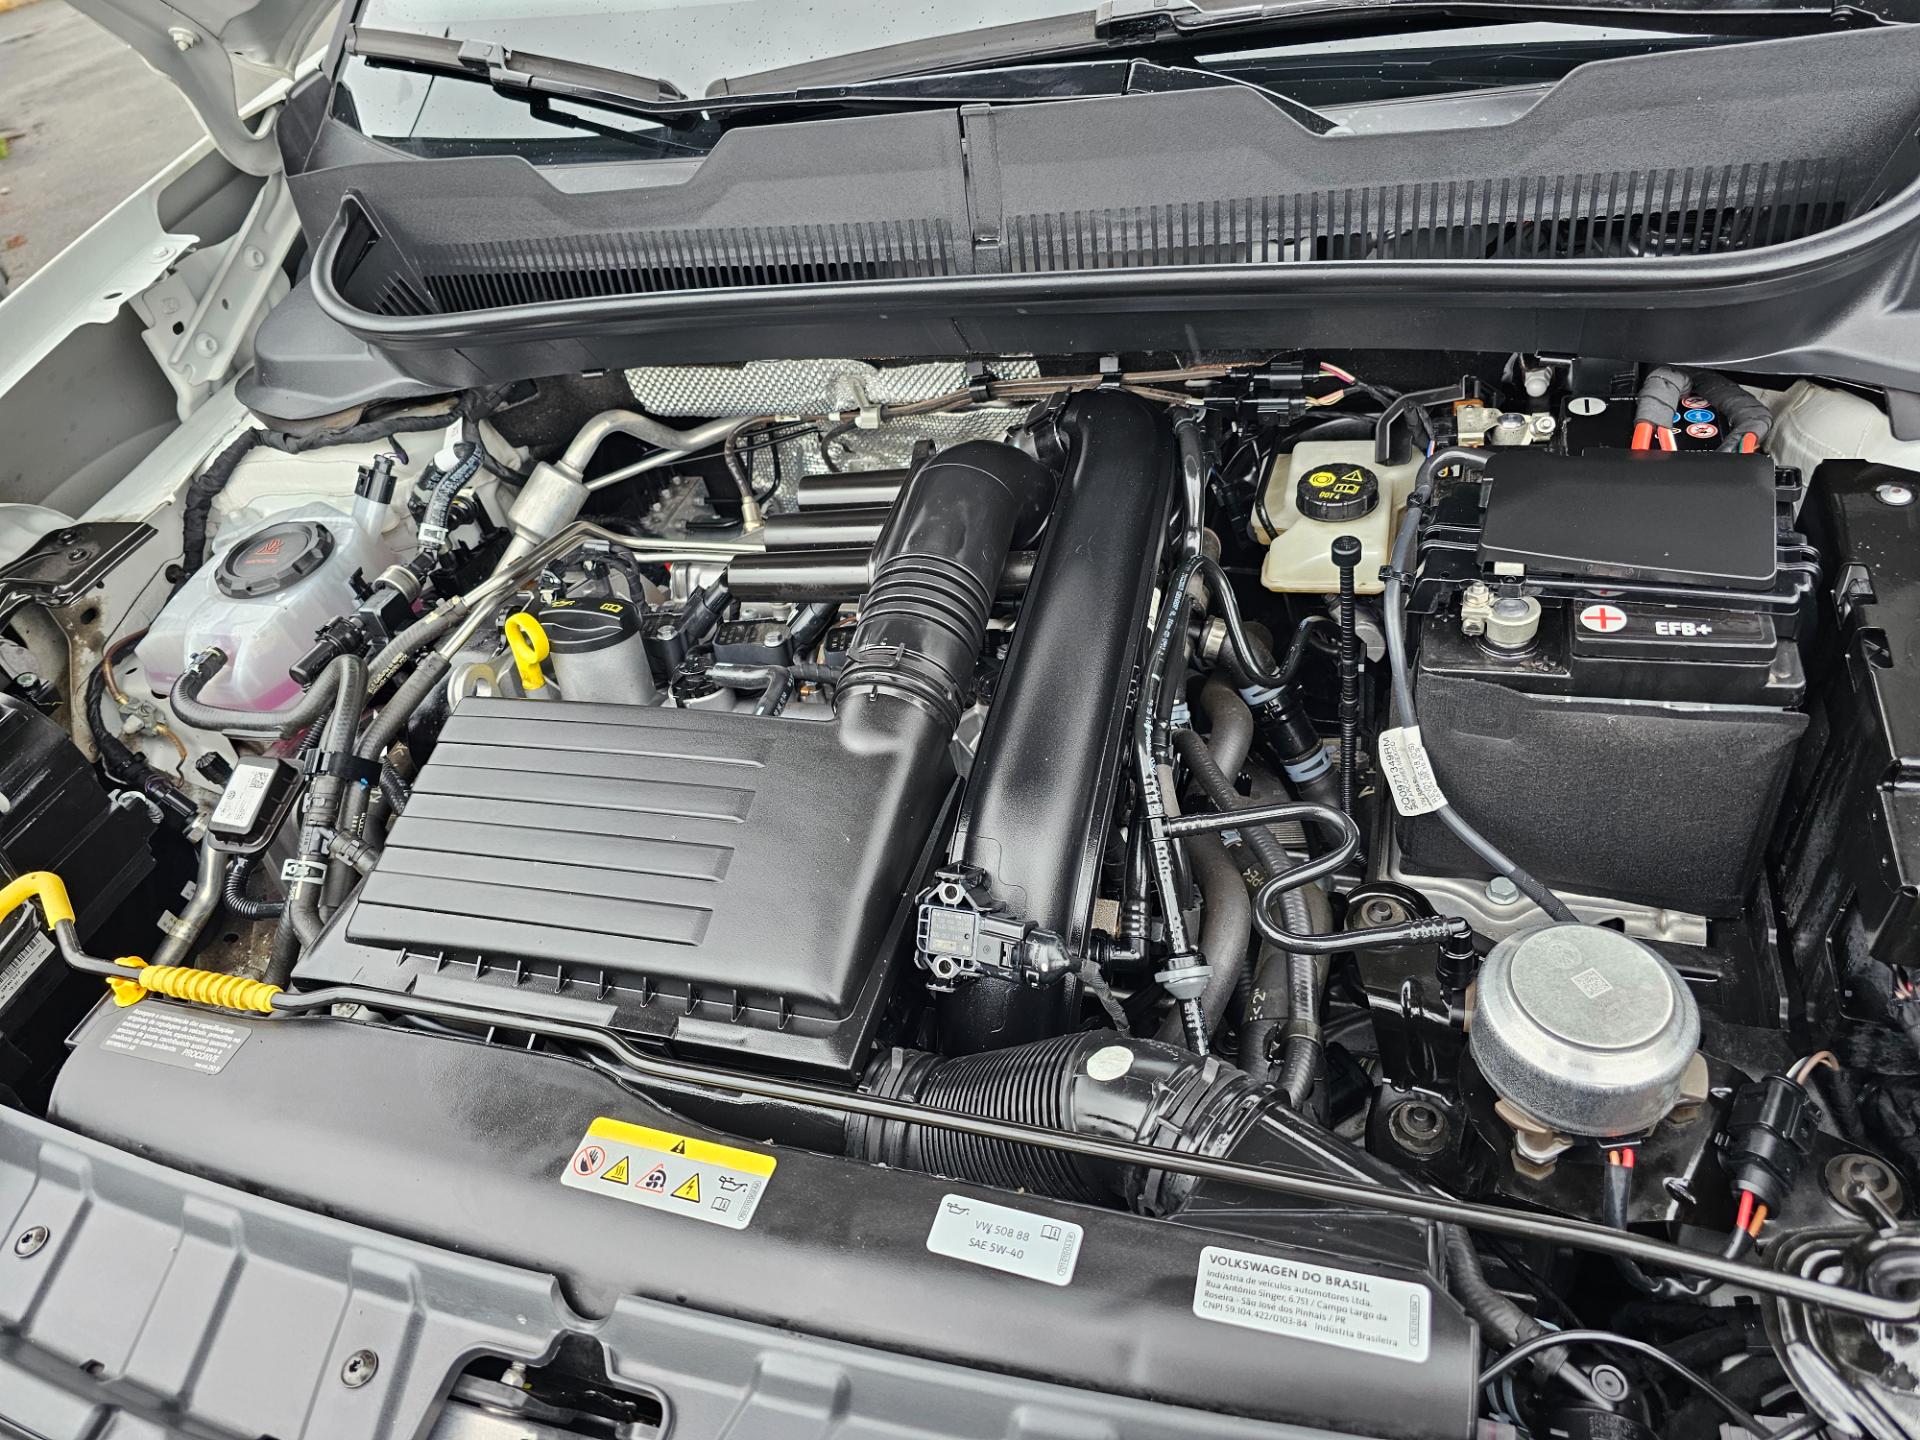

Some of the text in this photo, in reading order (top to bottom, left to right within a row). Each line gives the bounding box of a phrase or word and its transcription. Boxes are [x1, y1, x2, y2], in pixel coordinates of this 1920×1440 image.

[1319, 491, 1334, 499] DOT
[1655, 621, 1713, 637] EFB+
[994, 1225, 1013, 1238] 508
[1016, 1230, 1030, 1242] 88
[968, 1237, 1024, 1259] SAE 5W-40
[1209, 1254, 1370, 1292] VOLKSWAGEN DO BRASIL
[1245, 1276, 1256, 1284] de
[1294, 1286, 1349, 1303] automotores
[1316, 1300, 1347, 1313] Campo
[1350, 1305, 1374, 1320] Largo
